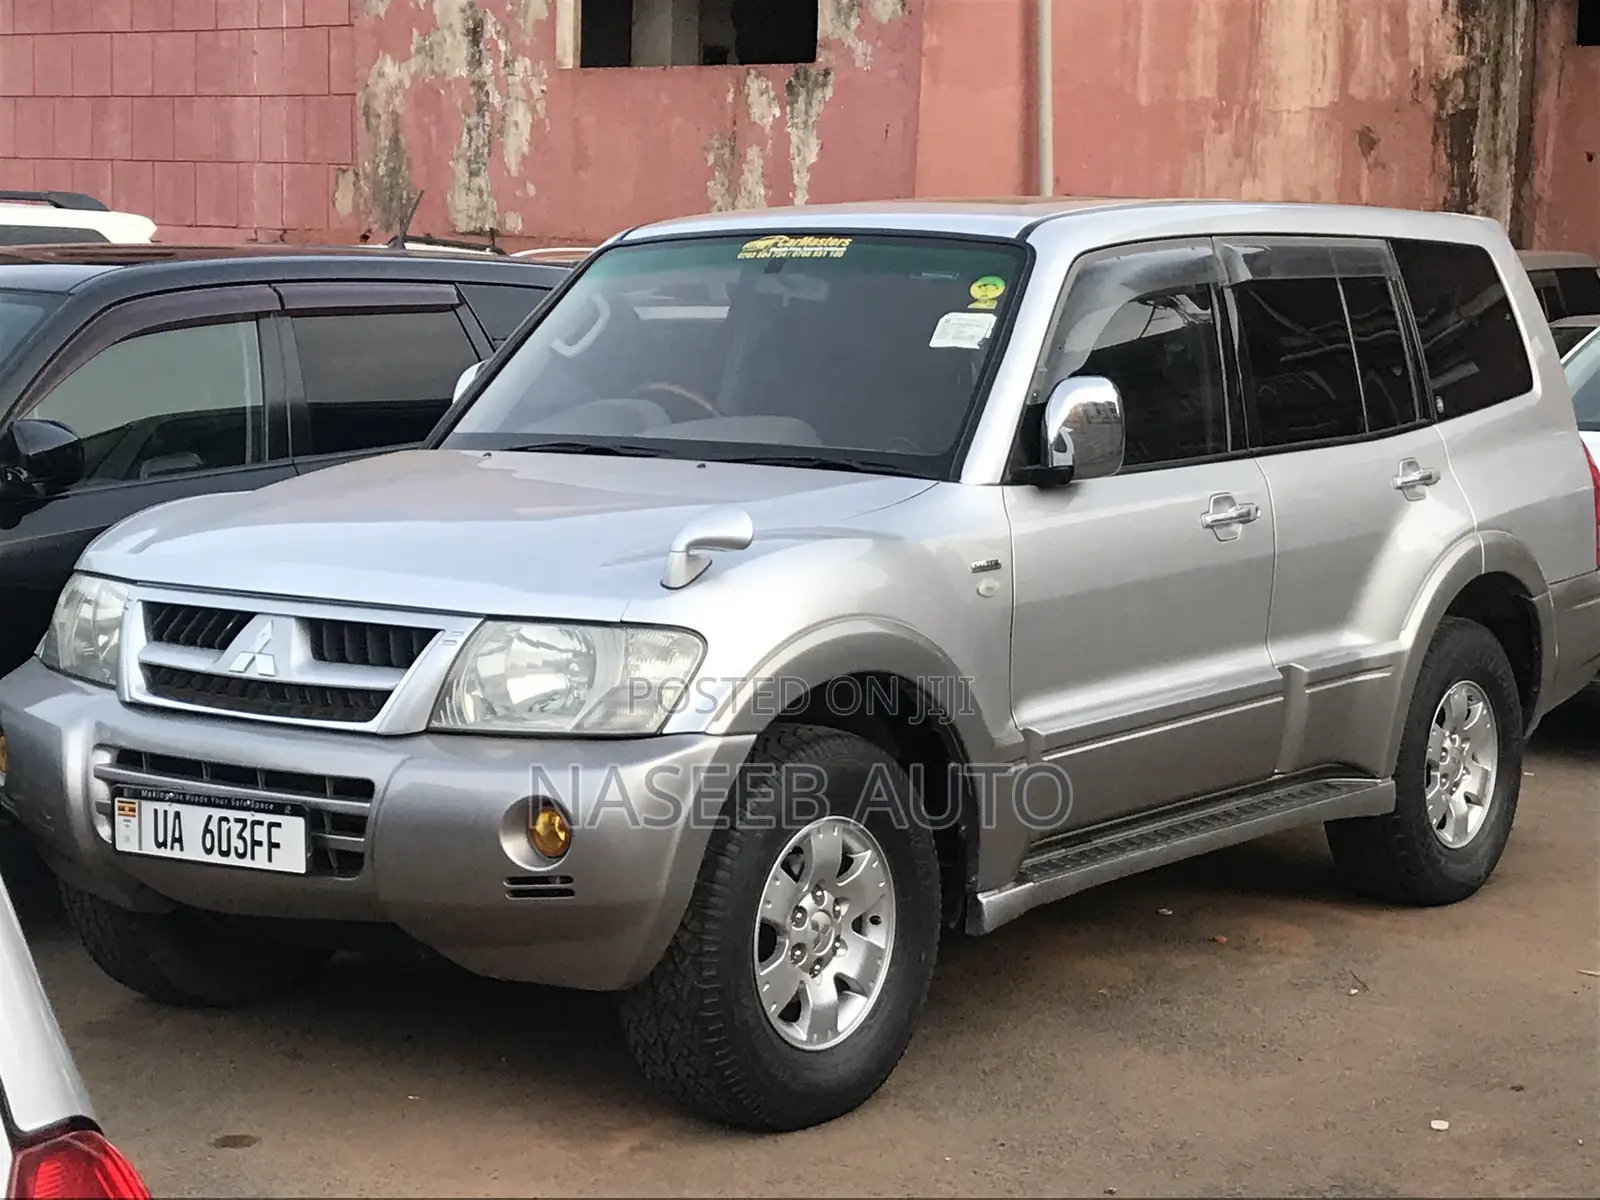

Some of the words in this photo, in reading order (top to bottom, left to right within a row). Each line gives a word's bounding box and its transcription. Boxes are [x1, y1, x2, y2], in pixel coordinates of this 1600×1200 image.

[250, 800, 275, 811] Space
[154, 808, 184, 852] UA
[202, 814, 282, 863] 603FF
